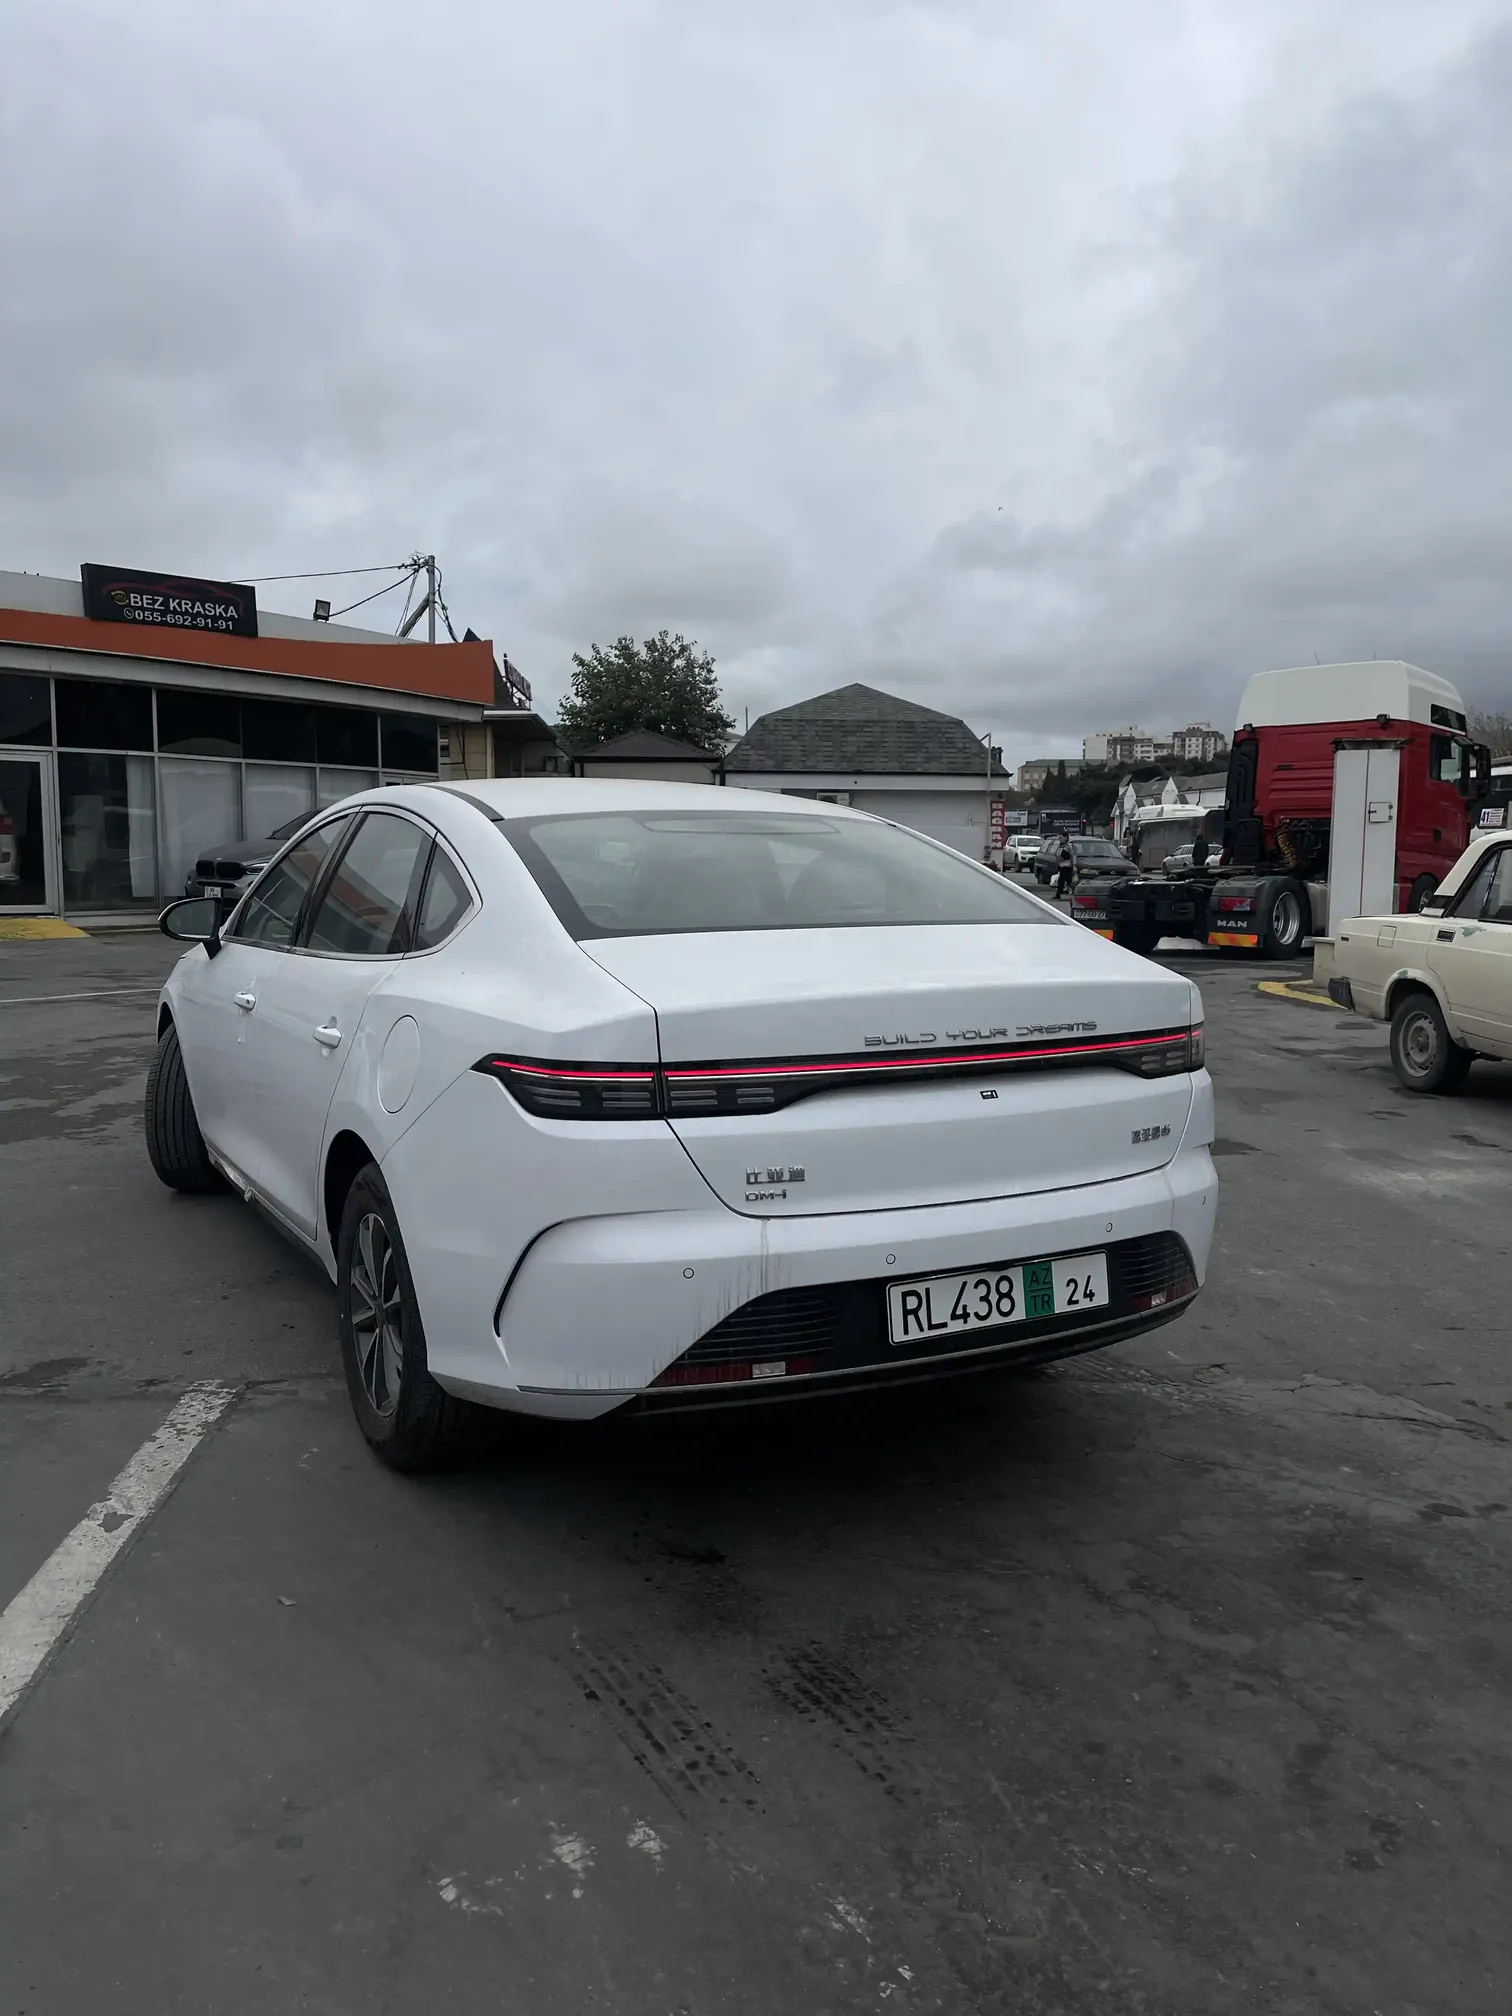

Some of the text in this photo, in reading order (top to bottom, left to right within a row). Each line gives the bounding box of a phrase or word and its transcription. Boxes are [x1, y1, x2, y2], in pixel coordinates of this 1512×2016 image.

[129, 593, 239, 619] BEZ KRASKA
[134, 610, 234, 630] 055-692-91-91
[1216, 919, 1248, 928] MAN
[864, 1021, 1098, 1046] BUILD YOUR DREAMS
[1029, 1267, 1051, 1288] AZ
[1065, 1274, 1096, 1306] 24
[900, 1274, 1016, 1336] RL438
[1030, 1293, 1052, 1313] TR
